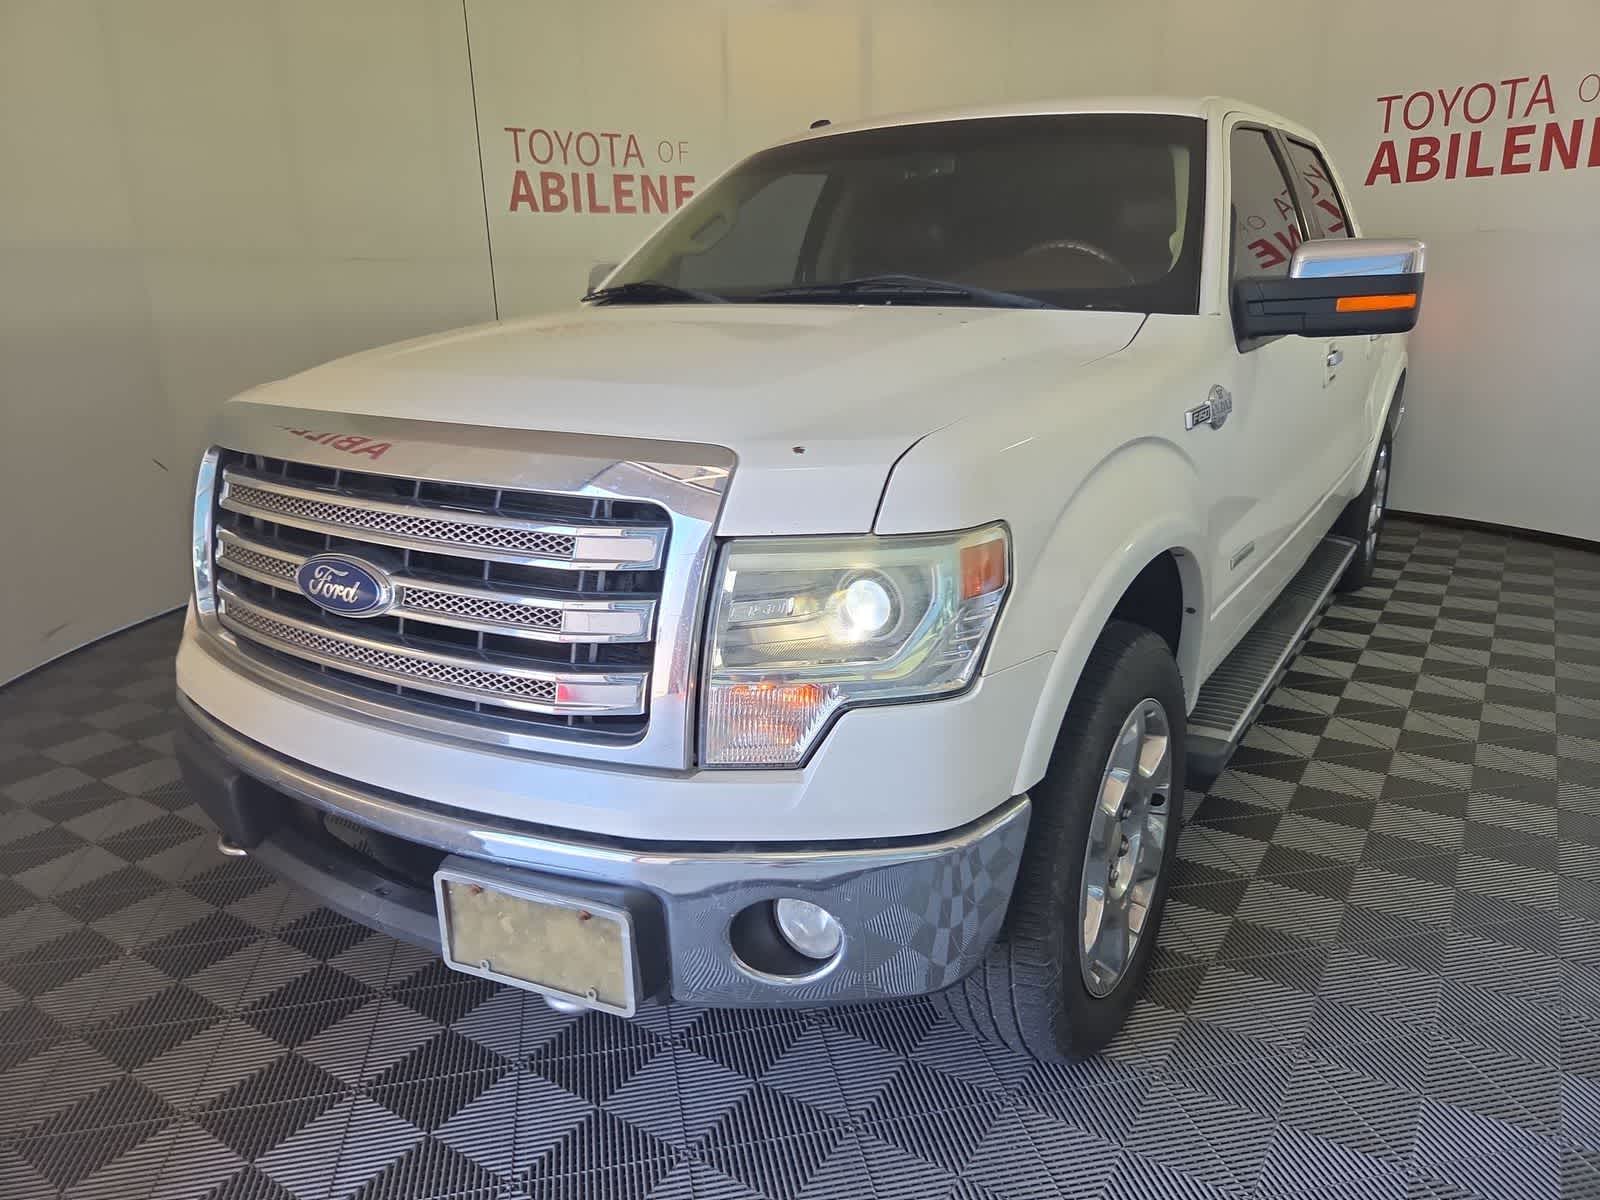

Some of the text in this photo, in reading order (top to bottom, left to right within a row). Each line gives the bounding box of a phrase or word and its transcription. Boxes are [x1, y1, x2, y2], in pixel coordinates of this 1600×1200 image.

[1376, 73, 1600, 134] TOYOTA O
[504, 127, 689, 168] TOYOTA OF
[308, 565, 360, 604] Ford
